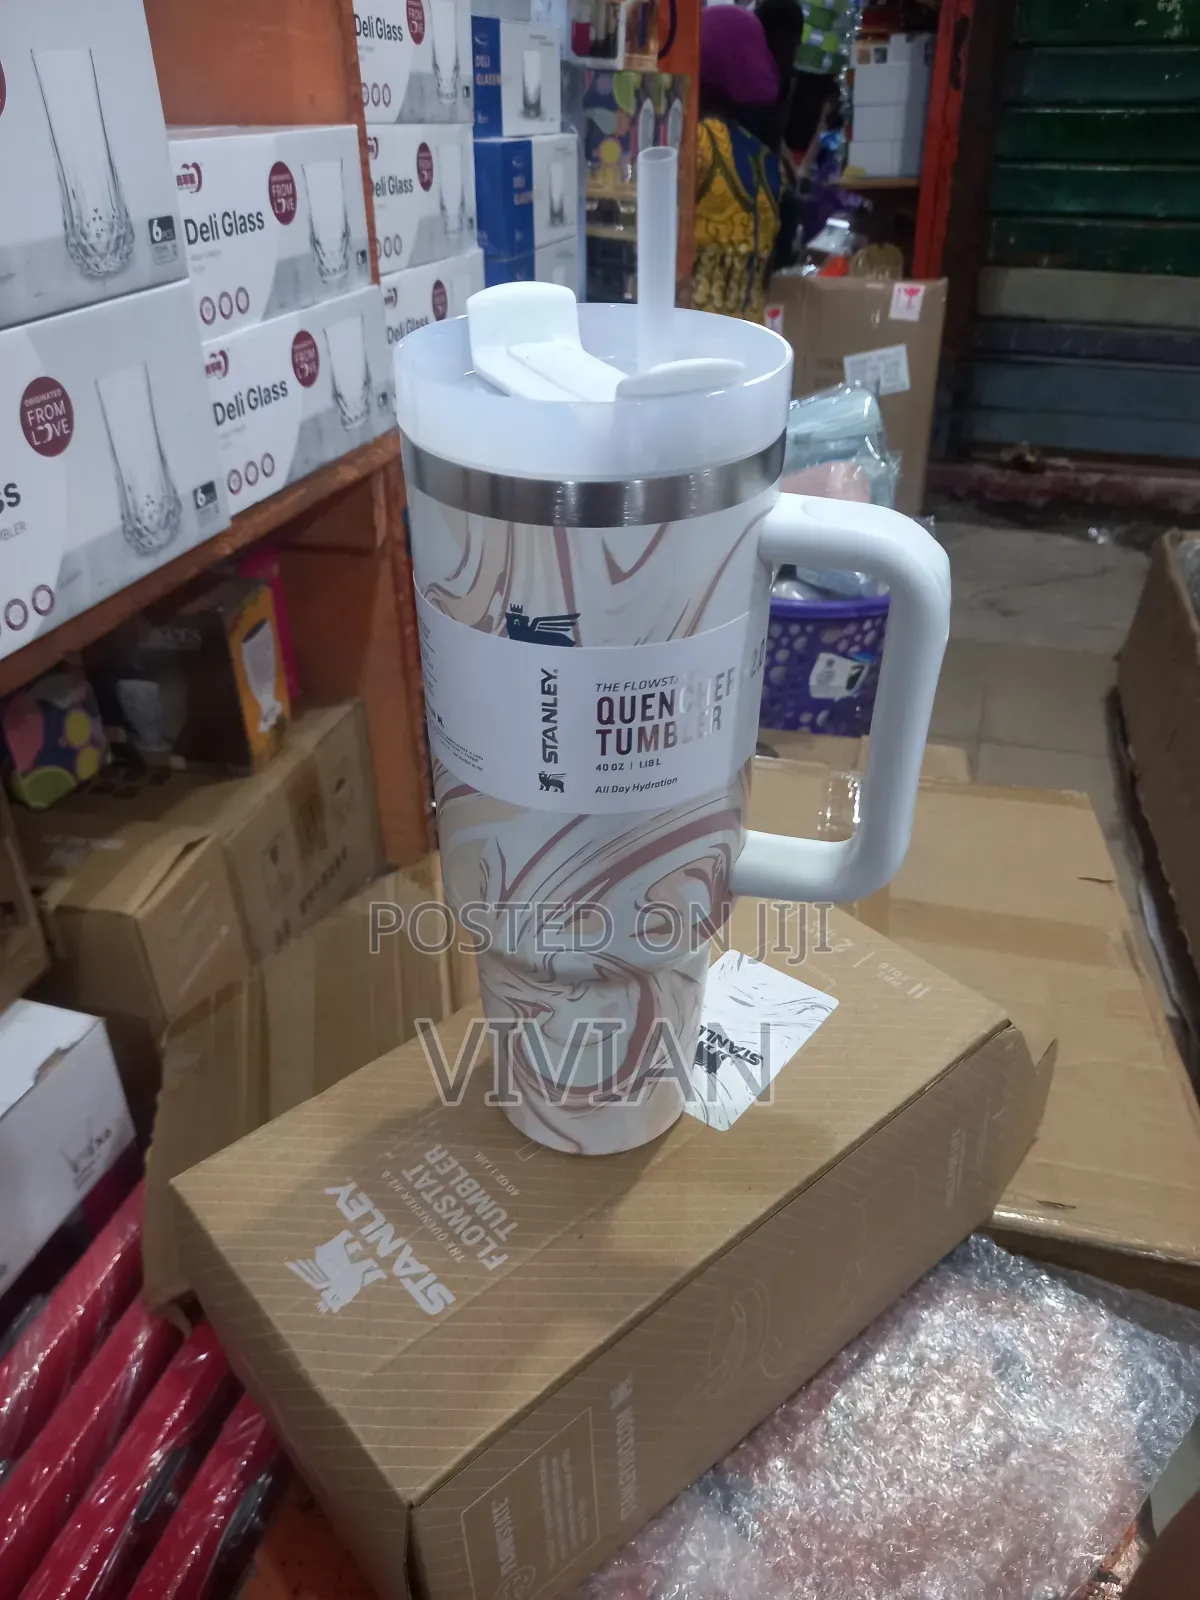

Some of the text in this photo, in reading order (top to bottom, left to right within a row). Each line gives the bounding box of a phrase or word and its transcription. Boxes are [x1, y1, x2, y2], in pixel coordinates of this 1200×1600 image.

[354, 13, 403, 42] Deli Glass
[271, 183, 293, 198] FROM
[374, 176, 387, 198] eli
[387, 175, 414, 196] Glass
[183, 210, 265, 245] Deli Glass
[386, 322, 405, 345] Deli
[24, 387, 63, 408] ORIGINATED
[212, 380, 288, 427] Deli Glass
[26, 400, 66, 427] FROM
[595, 673, 690, 693] THE FLOWST
[541, 667, 559, 765] STANLEY
[595, 705, 723, 757] TUMBLER
[595, 763, 609, 772] 40
[611, 762, 625, 771] OZ
[595, 776, 678, 795] All Day Hydration
[697, 1024, 765, 1067] STANL
[423, 1142, 519, 1243] TUMBLER
[399, 1190, 449, 1244] QUENCHER
[323, 1180, 457, 1316] STANLEY
[443, 1244, 466, 1264] THE
